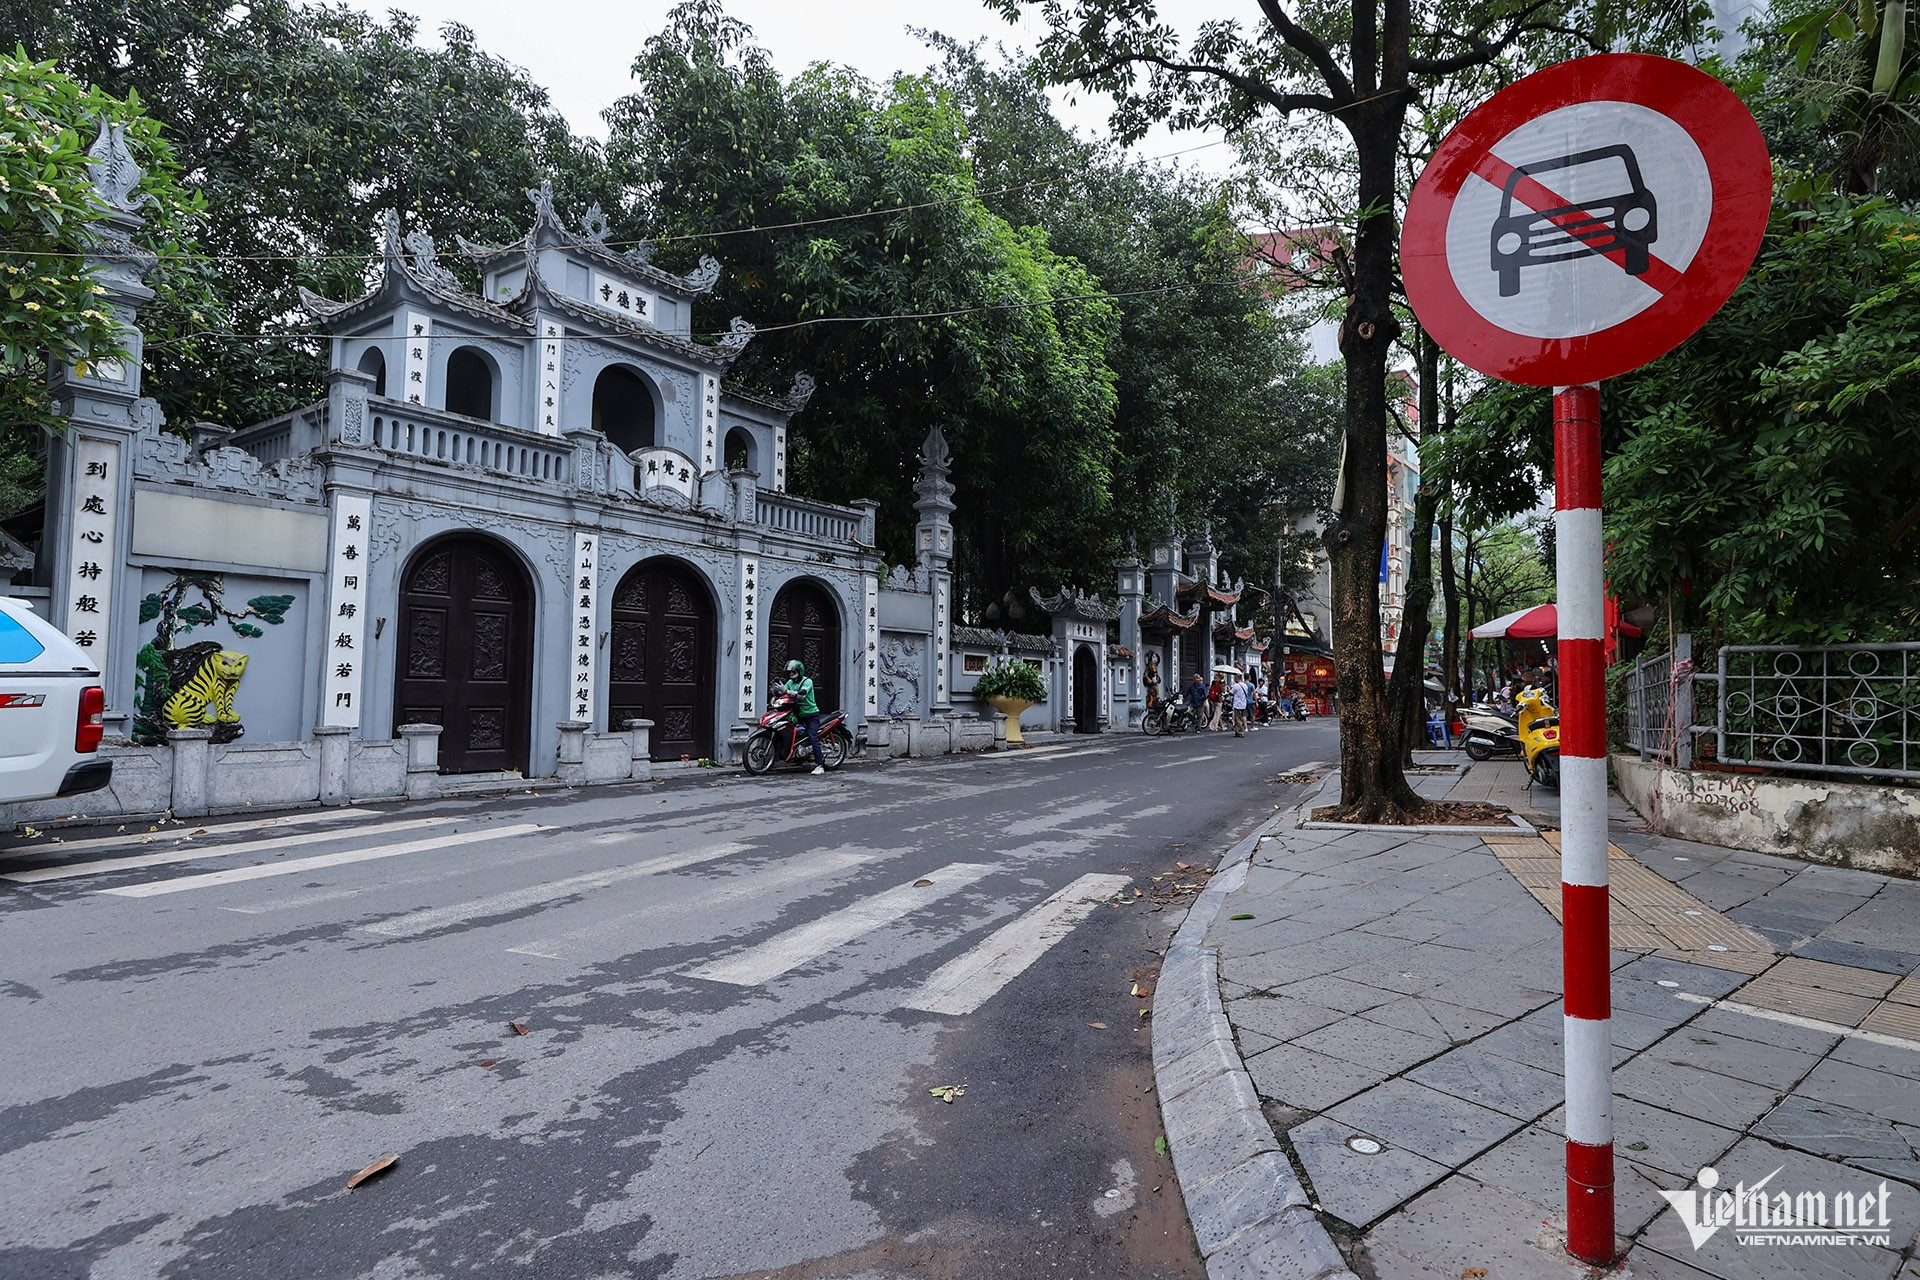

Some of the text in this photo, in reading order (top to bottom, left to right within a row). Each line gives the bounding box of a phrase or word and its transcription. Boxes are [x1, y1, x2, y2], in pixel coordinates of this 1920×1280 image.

[544, 325, 557, 437] 高門出入善良
[334, 514, 361, 708] 萬善同歸般若門
